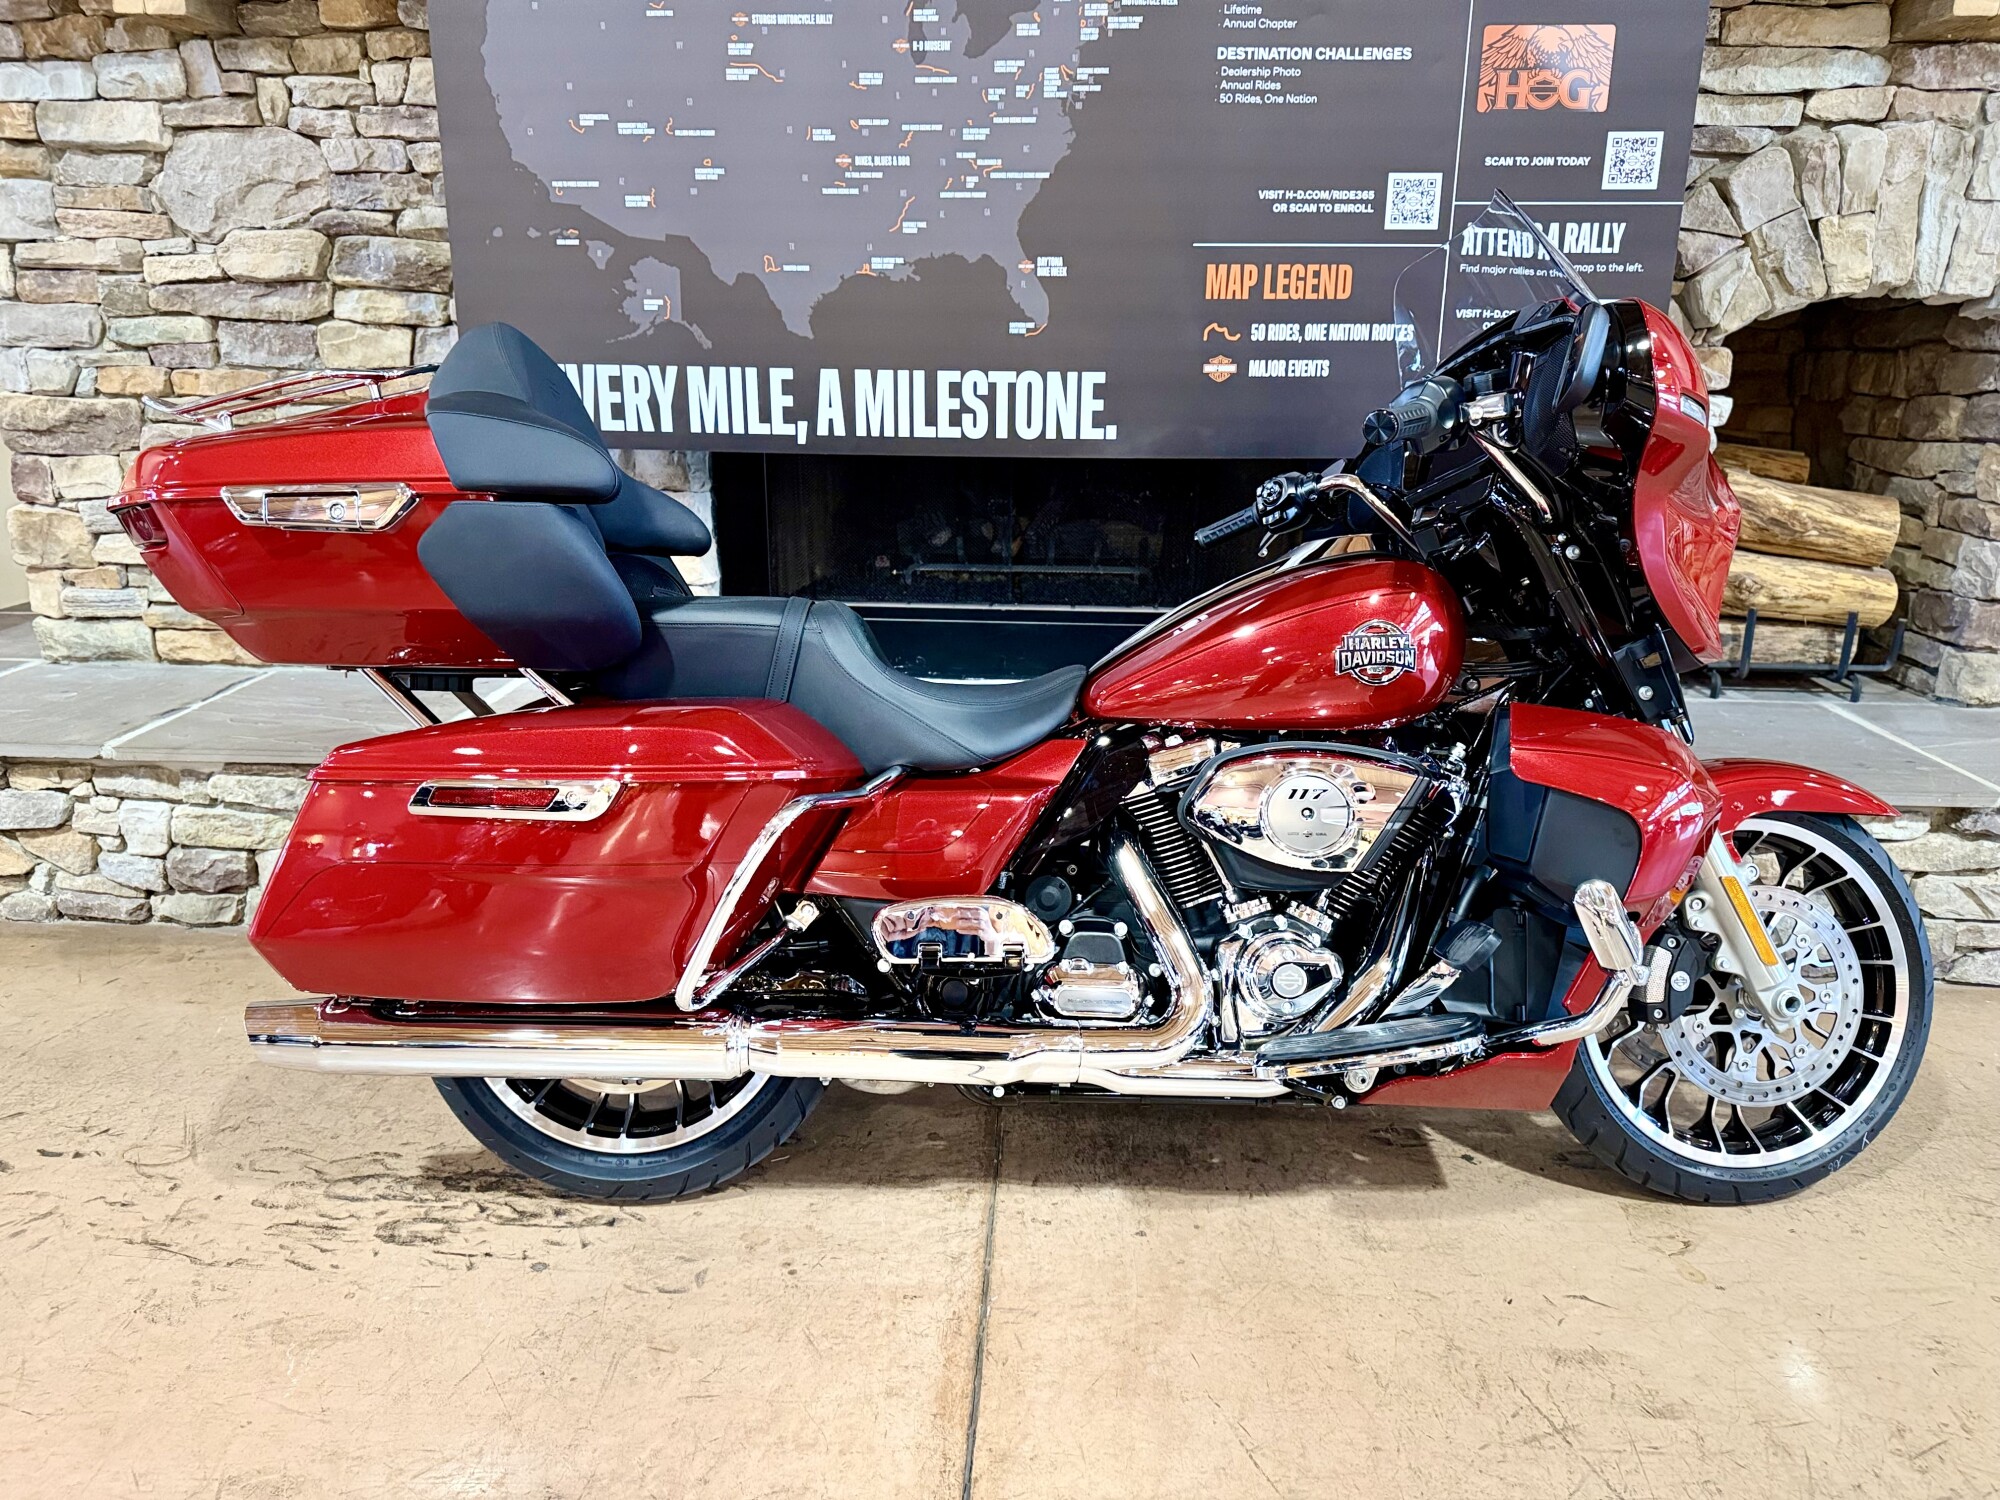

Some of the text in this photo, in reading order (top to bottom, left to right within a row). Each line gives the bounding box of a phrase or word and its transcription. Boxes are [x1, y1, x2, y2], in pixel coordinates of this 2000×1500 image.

[1224, 5, 1262, 14] Lifetime
[752, 14, 776, 25] STURGIS
[778, 14, 814, 25] MOTORCYCLE
[1222, 19, 1297, 30] Annual Chapter
[1216, 47, 1412, 60] DESTINATION CHALLENGES
[1220, 66, 1301, 78] Dealership Photo
[1220, 80, 1281, 90] Annual Rides
[1220, 94, 1318, 104] 50 Rides, One Nation
[1484, 156, 1592, 167] SCAN TO JOIN TODAY
[1259, 190, 1375, 200] VISIT H-D.COM/RIDE365
[1272, 204, 1374, 213] OR SCAN TO ENROLL
[1460, 222, 1535, 259] ATTEND
[1563, 222, 1627, 254] RALLY
[1037, 257, 1063, 266] DAYTONA
[1460, 264, 1480, 273] Find
[1482, 265, 1507, 276] major
[1509, 266, 1535, 276] rallies
[1572, 264, 1594, 274] map
[1596, 264, 1606, 272] to
[1608, 263, 1624, 272] the
[1626, 262, 1644, 272] left.
[1021, 280, 1026, 289] FL
[1205, 264, 1353, 300] MAP LEGEND
[1456, 309, 1481, 318] VISIT
[1250, 324, 1414, 342] 50 RIDES, ONE NATION ROUTES
[1248, 360, 1330, 377] MAJOR EVENTS
[557, 364, 1118, 444] VERY MILE, A MILESTONE.
[1348, 636, 1410, 650] HARLEY-
[1340, 650, 1414, 671] DAVIDSON
[1288, 788, 1329, 800] 117
